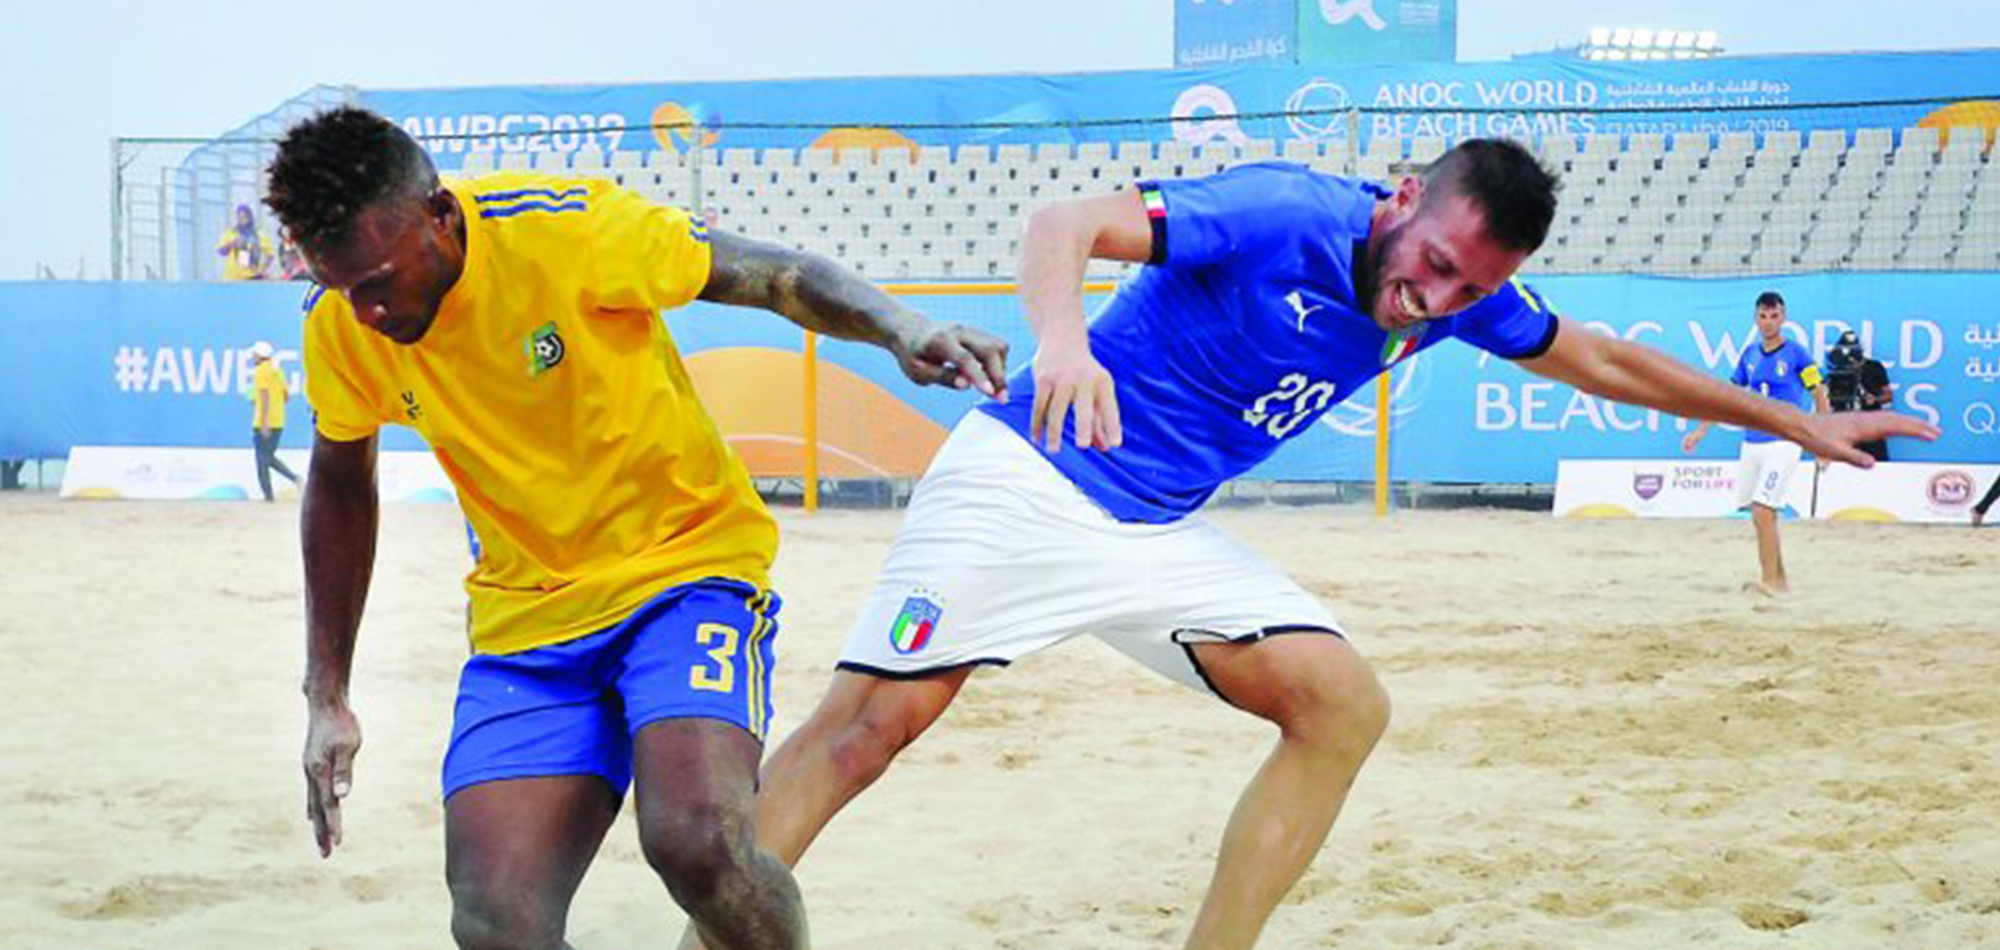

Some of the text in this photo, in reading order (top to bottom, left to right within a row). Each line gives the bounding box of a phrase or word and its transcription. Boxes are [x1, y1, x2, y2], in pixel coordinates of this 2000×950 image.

[1374, 82, 1463, 107] ANOC
[1475, 80, 1598, 107] WORLD
[1372, 110, 1596, 138] BEACH GAMES
[1243, 372, 1336, 440] 20
[1674, 467, 1723, 478] SPORT
[1704, 479, 1735, 490] LIFE
[690, 622, 739, 692] 3
